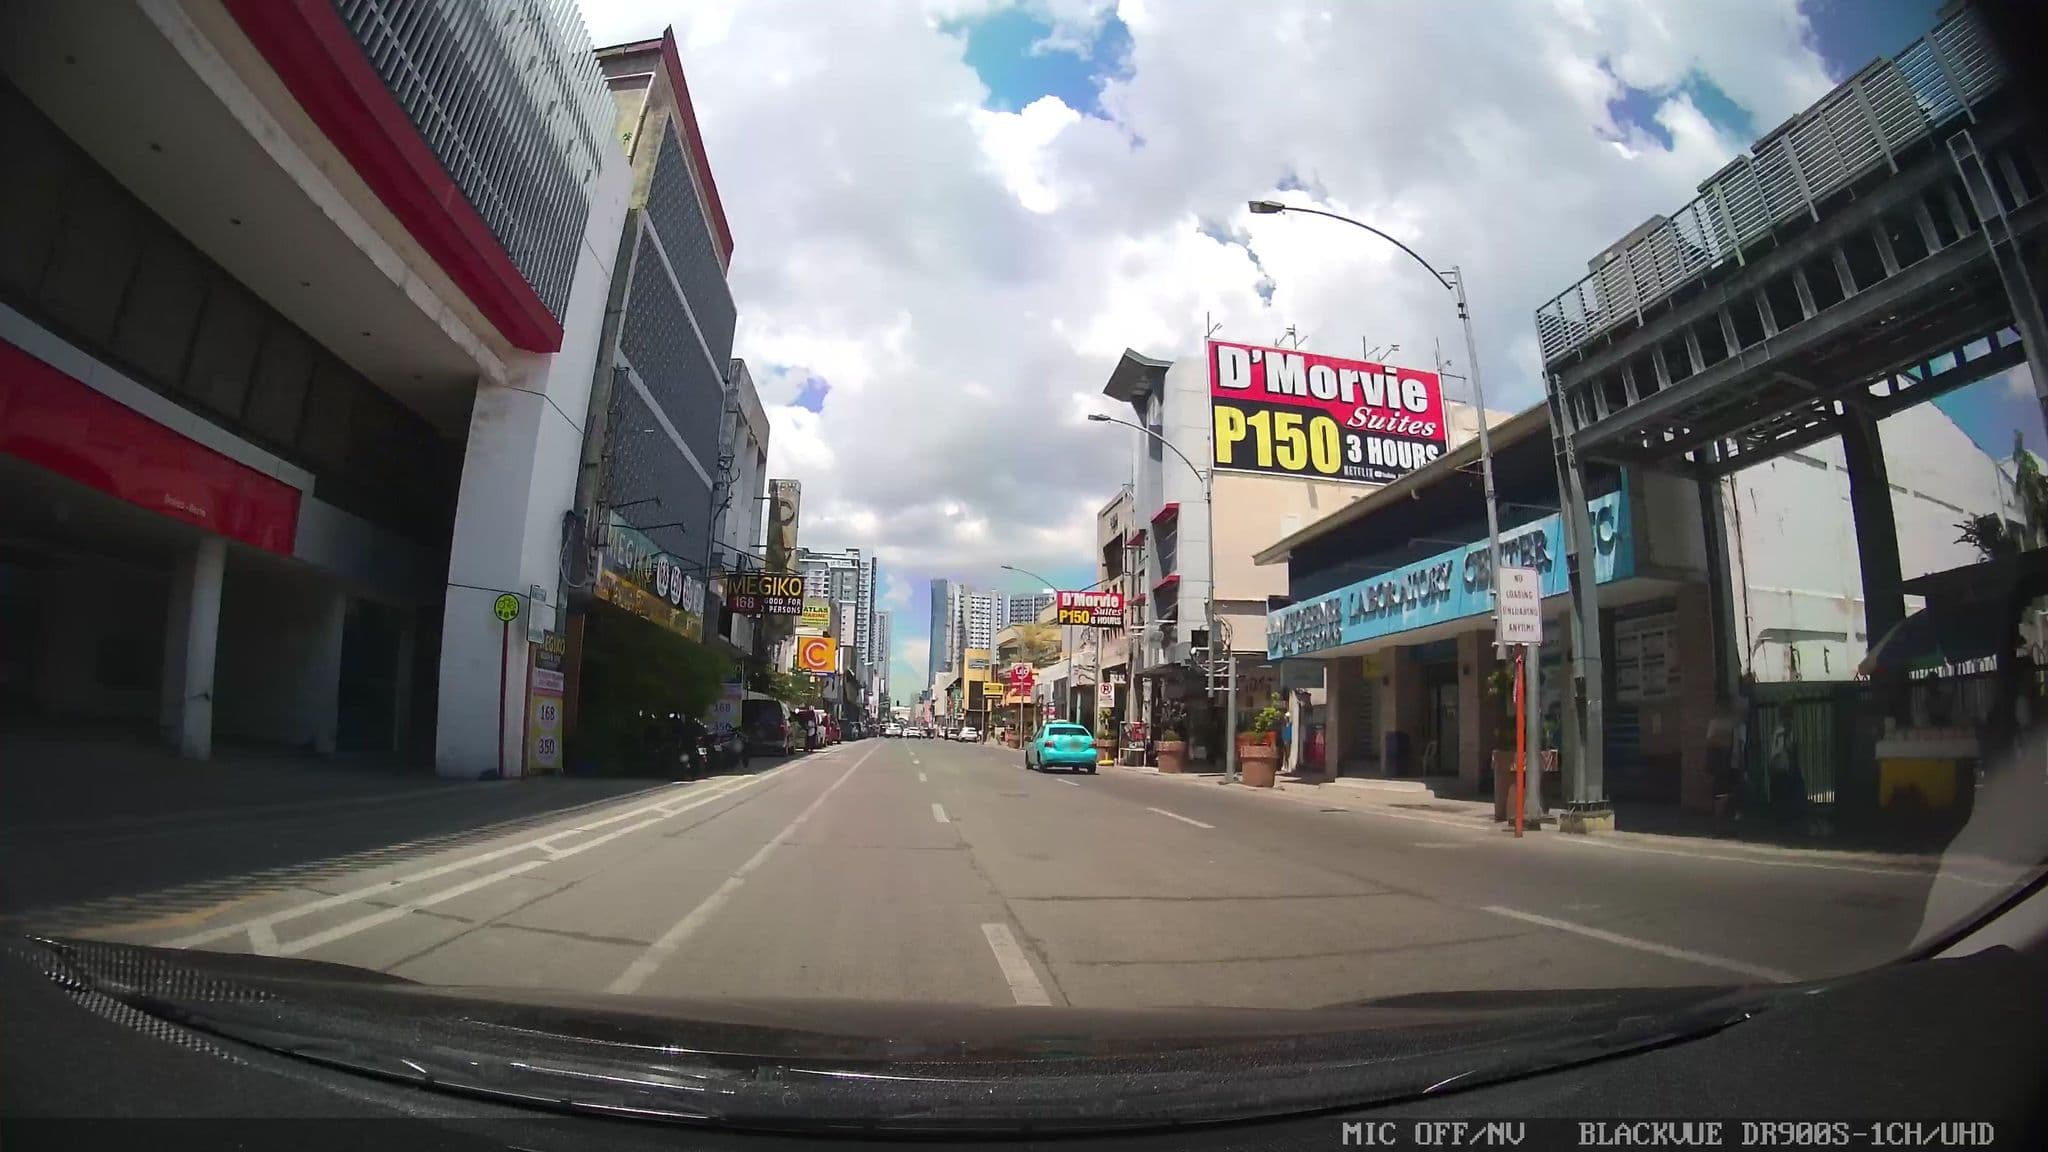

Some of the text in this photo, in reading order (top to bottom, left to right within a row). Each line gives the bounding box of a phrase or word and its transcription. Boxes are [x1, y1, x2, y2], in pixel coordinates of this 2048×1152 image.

[1217, 344, 1428, 414] D'Morvie
[1346, 406, 1437, 437] Suites
[1214, 405, 1342, 474] P150
[1346, 434, 1439, 468] 3 HOURS
[1463, 529, 1552, 592] CETER
[728, 576, 802, 596] MEGIKO
[1514, 575, 1523, 583] NO
[736, 596, 755, 608] 168
[787, 598, 801, 606] FOR
[1062, 592, 1119, 608] D'Morvie
[1506, 591, 1533, 599] LOADING
[769, 605, 801, 614] PERSONS
[1059, 609, 1090, 624] P150
[1093, 606, 1122, 616] Suites
[1097, 616, 1121, 625] HOURS
[1508, 623, 1535, 632] ANYTIME
[540, 704, 555, 721] 168
[538, 738, 555, 754] 350
